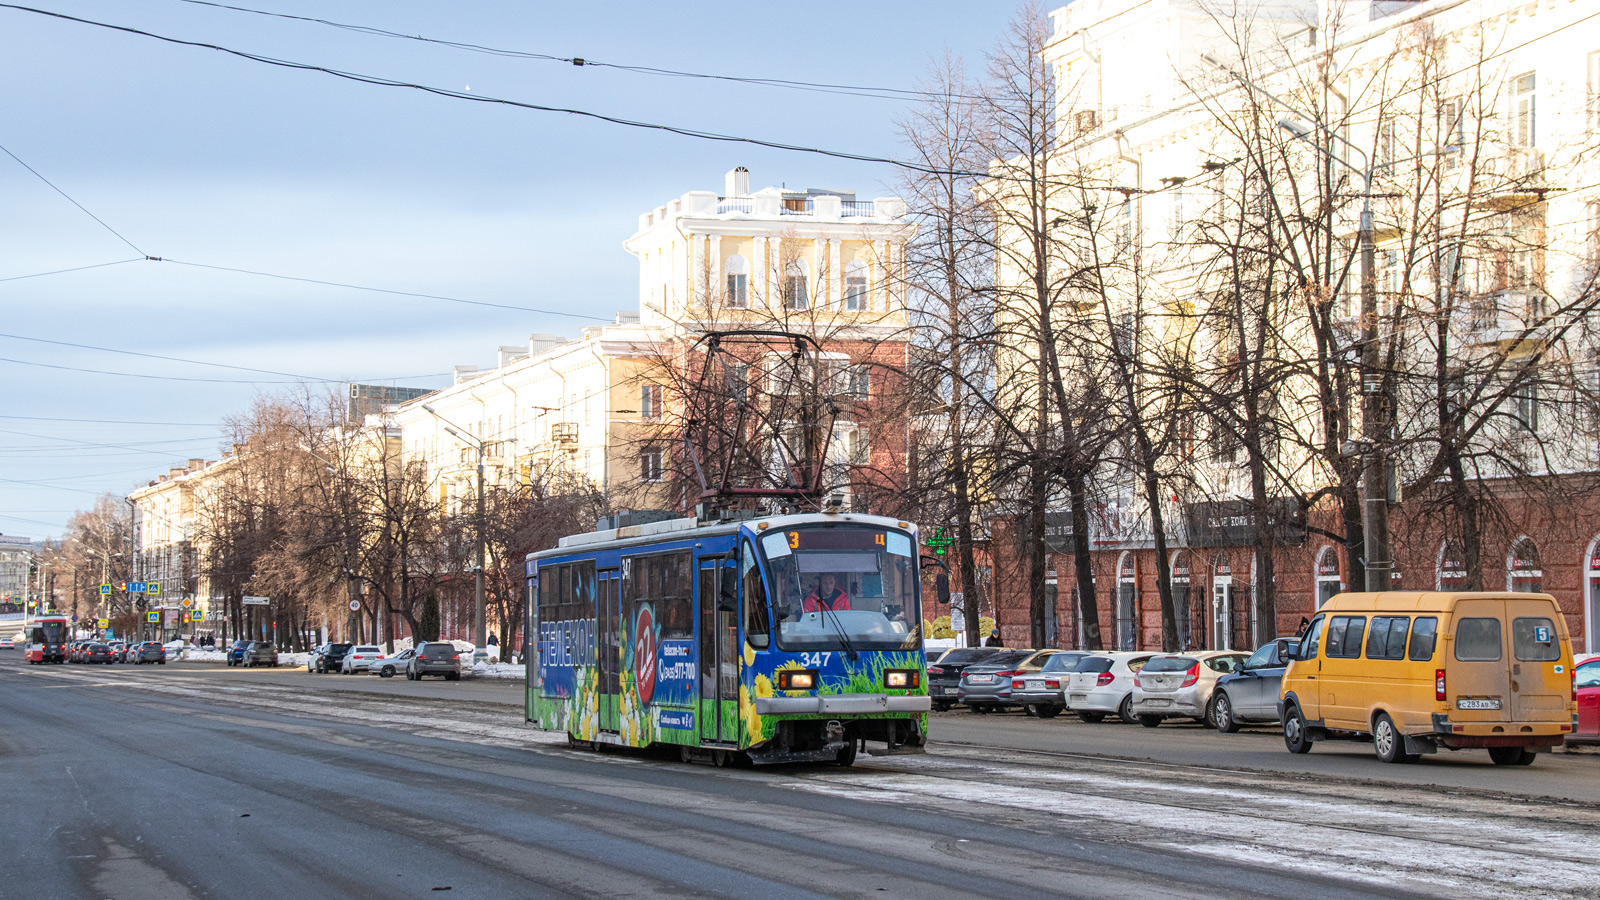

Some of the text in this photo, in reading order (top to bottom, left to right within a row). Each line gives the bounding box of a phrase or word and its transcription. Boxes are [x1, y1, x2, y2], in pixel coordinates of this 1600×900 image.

[789, 531, 800, 549] 3
[621, 558, 631, 580] 347
[540, 618, 596, 667] ТЕЛЕКОН
[1538, 627, 1547, 641] 5
[638, 625, 653, 679] 22
[800, 652, 832, 668] 347
[675, 661, 696, 680] 977-700
